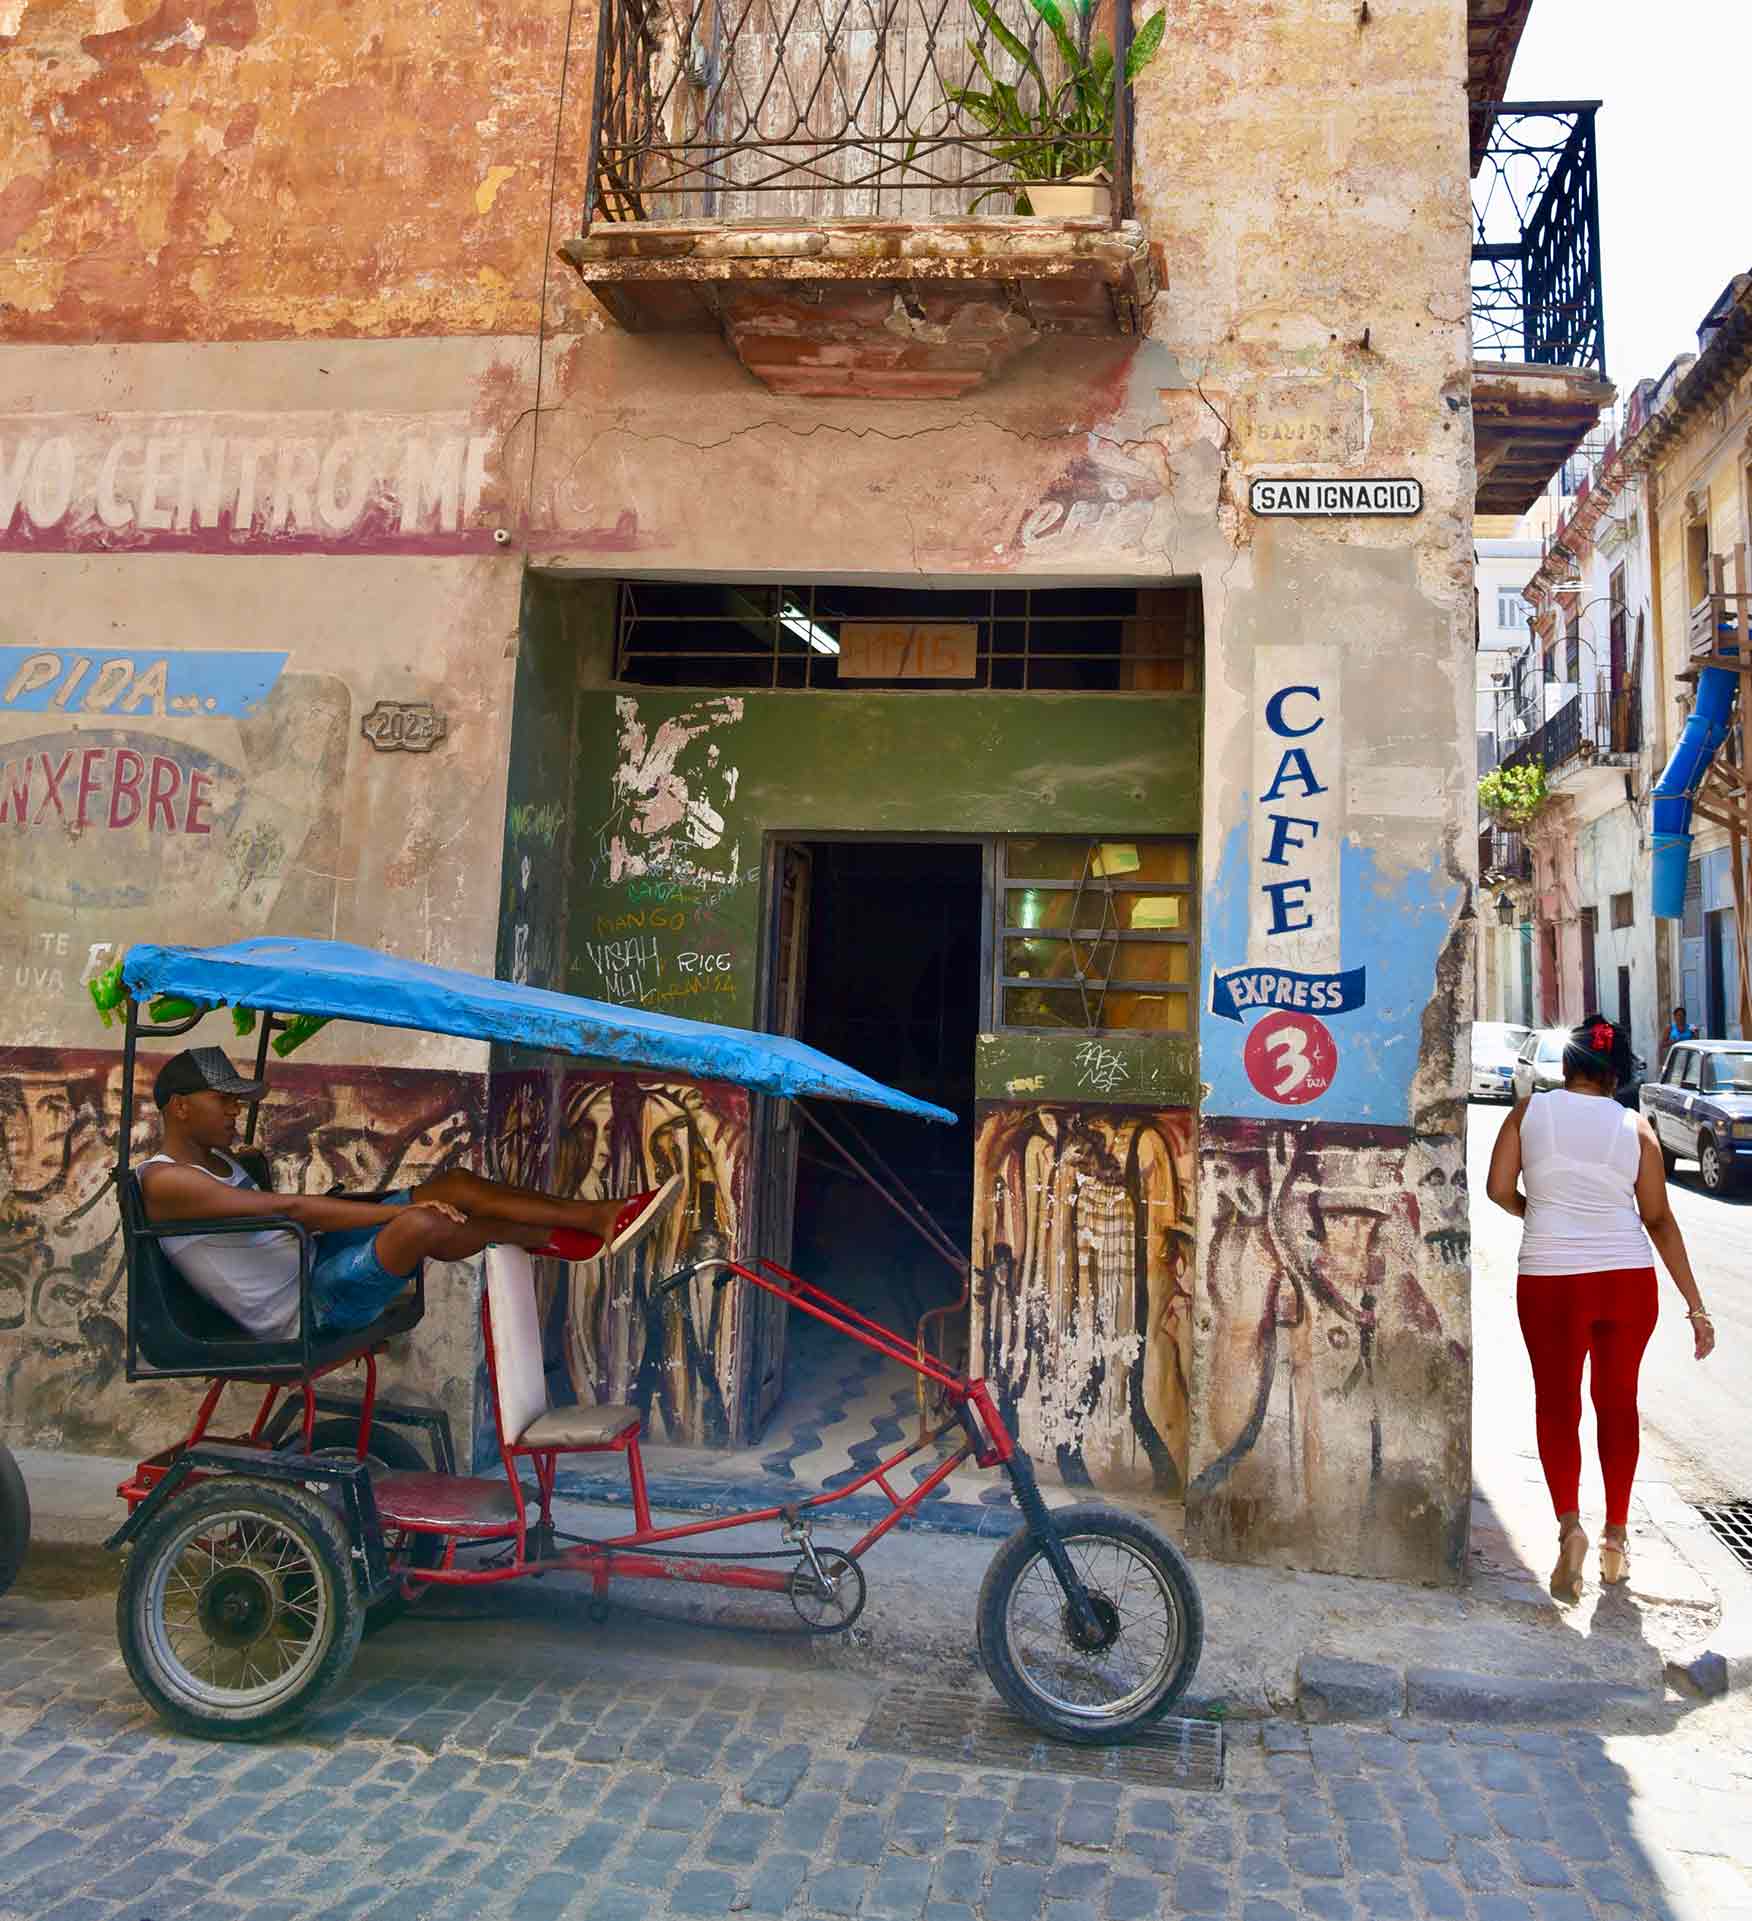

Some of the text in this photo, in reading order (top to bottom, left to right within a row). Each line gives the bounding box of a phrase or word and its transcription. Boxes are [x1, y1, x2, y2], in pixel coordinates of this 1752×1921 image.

[97, 434, 371, 536] CENTRO
[1261, 486, 1413, 509] SAN IGNACIO
[1259, 685, 1328, 935] CAFE
[15, 966, 64, 992] UVA
[1226, 974, 1343, 1009] EXPRESS
[1264, 1026, 1312, 1096] 3
[1304, 1076, 1328, 1089] TAZA
